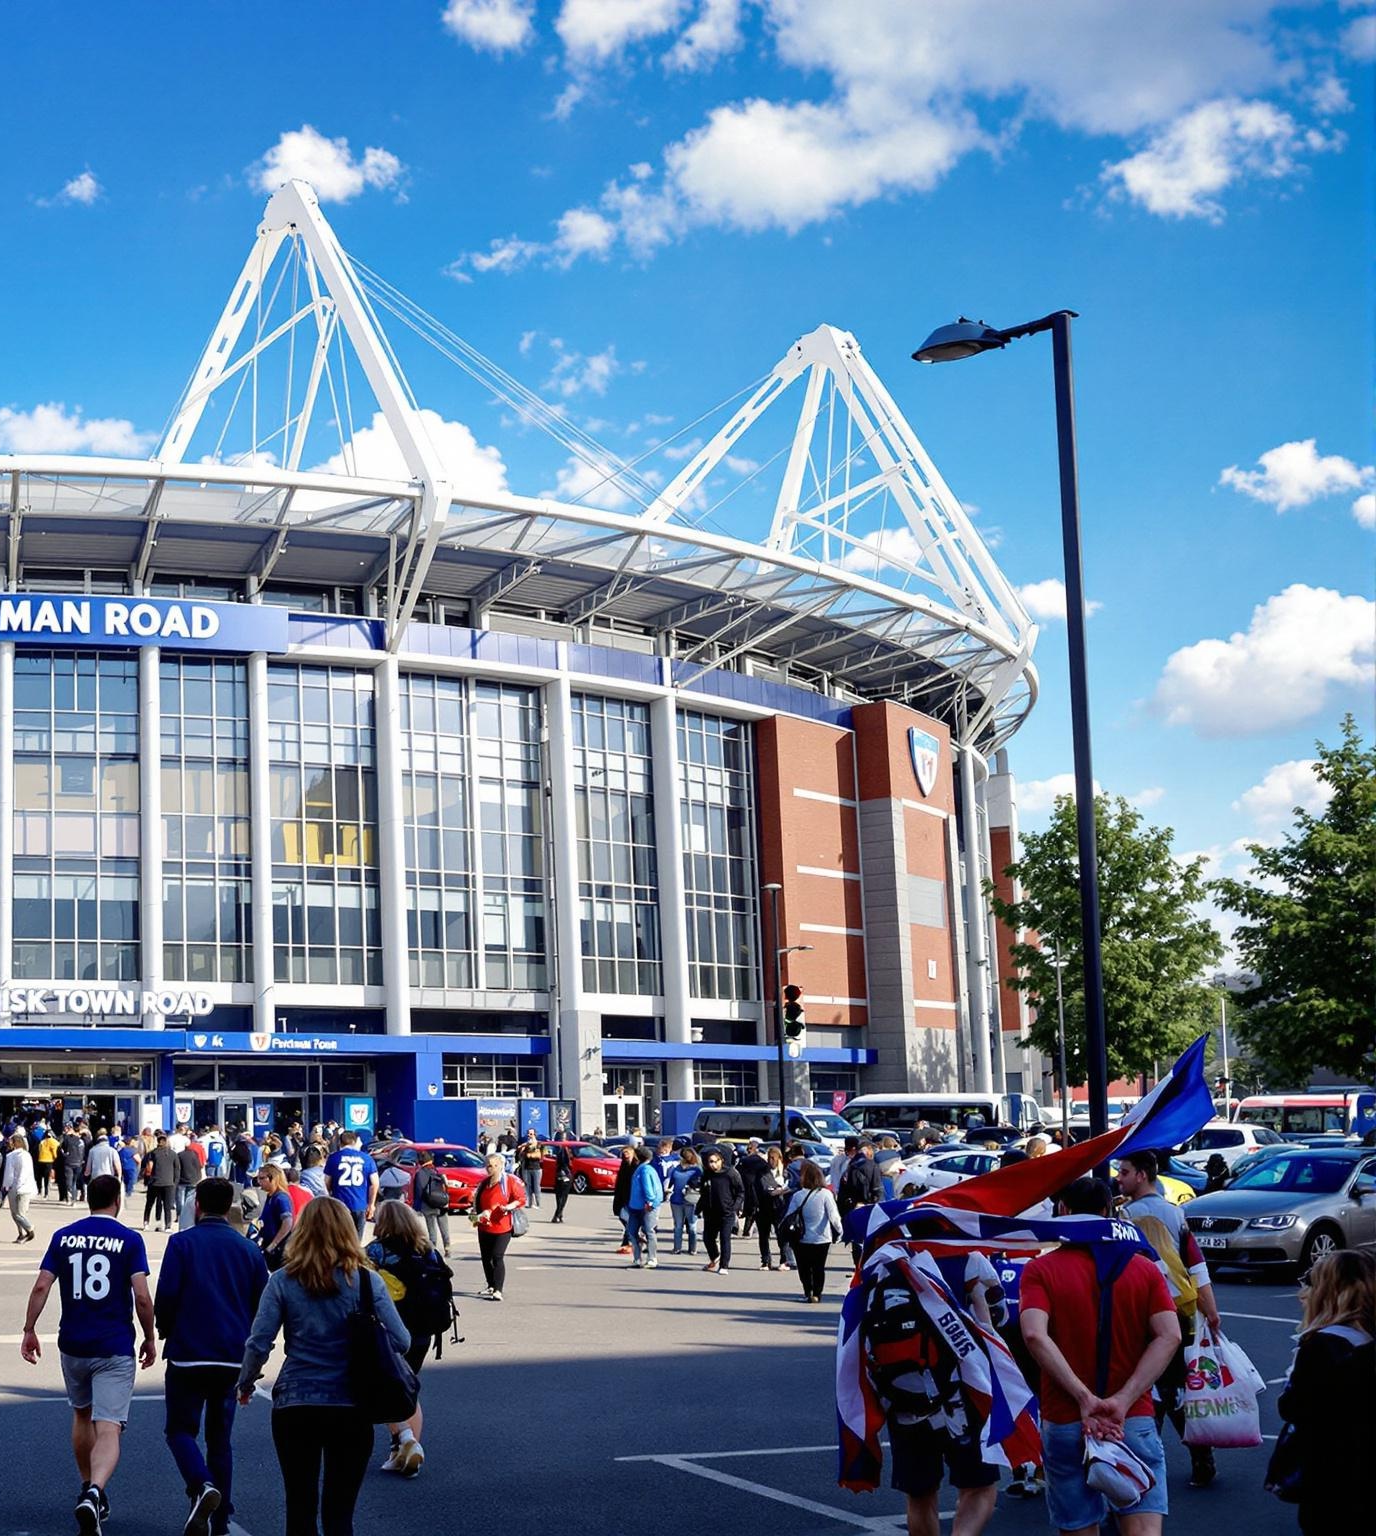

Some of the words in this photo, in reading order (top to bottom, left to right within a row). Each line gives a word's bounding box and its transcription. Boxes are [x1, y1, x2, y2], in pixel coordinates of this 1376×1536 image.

[105, 603, 220, 639] ROAD
[54, 989, 134, 1014] TOWN
[142, 990, 215, 1017] ROAD
[338, 1162, 364, 1187] 26
[68, 1252, 111, 1300] 18
